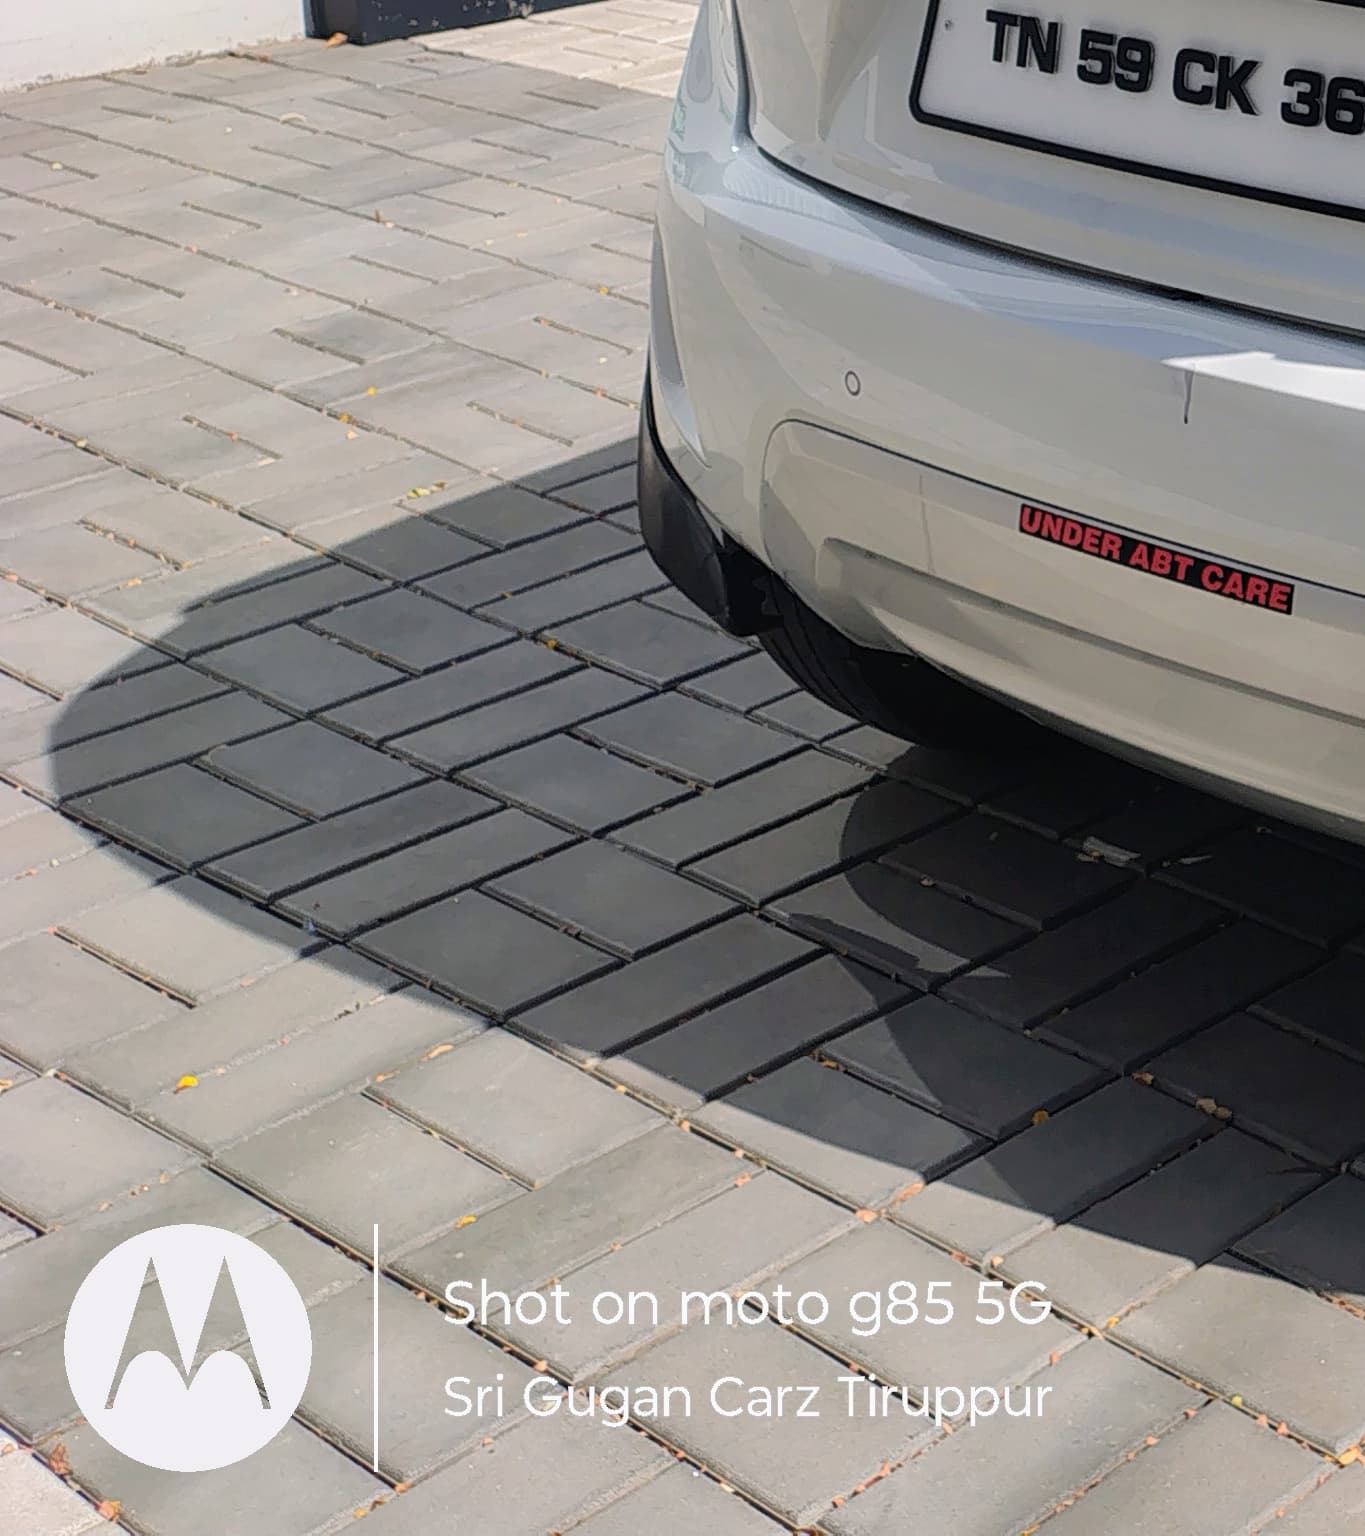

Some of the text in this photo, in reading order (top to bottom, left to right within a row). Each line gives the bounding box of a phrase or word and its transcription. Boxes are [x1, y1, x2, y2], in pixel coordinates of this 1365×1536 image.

[986, 8, 1064, 76] TN
[1076, 27, 1157, 94] 59
[1172, 47, 1261, 118] CK
[1020, 507, 1292, 611] UNDER ABT CARE
